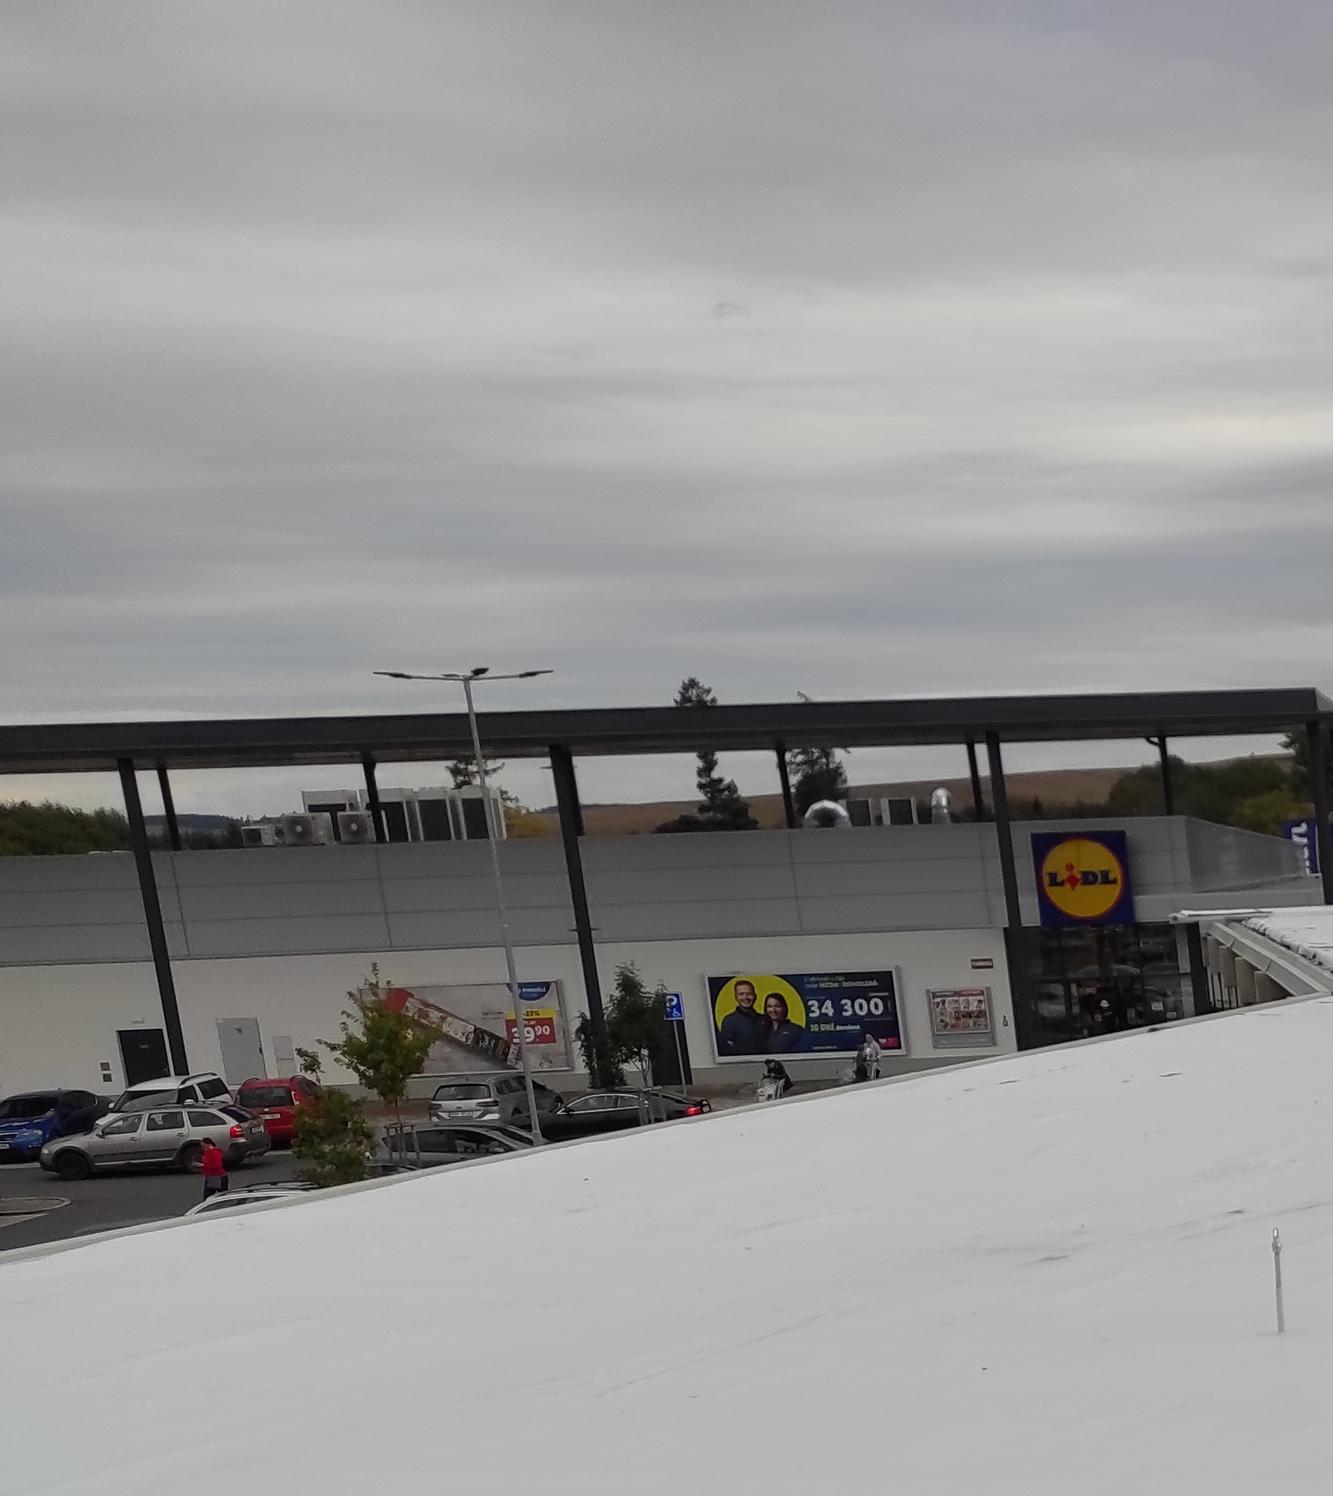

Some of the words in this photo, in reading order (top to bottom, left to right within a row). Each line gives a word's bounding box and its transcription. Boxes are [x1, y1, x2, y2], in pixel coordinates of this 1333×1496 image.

[1047, 862, 1118, 890] LIDL
[807, 999, 835, 1017] 34
[840, 997, 884, 1016] 300
